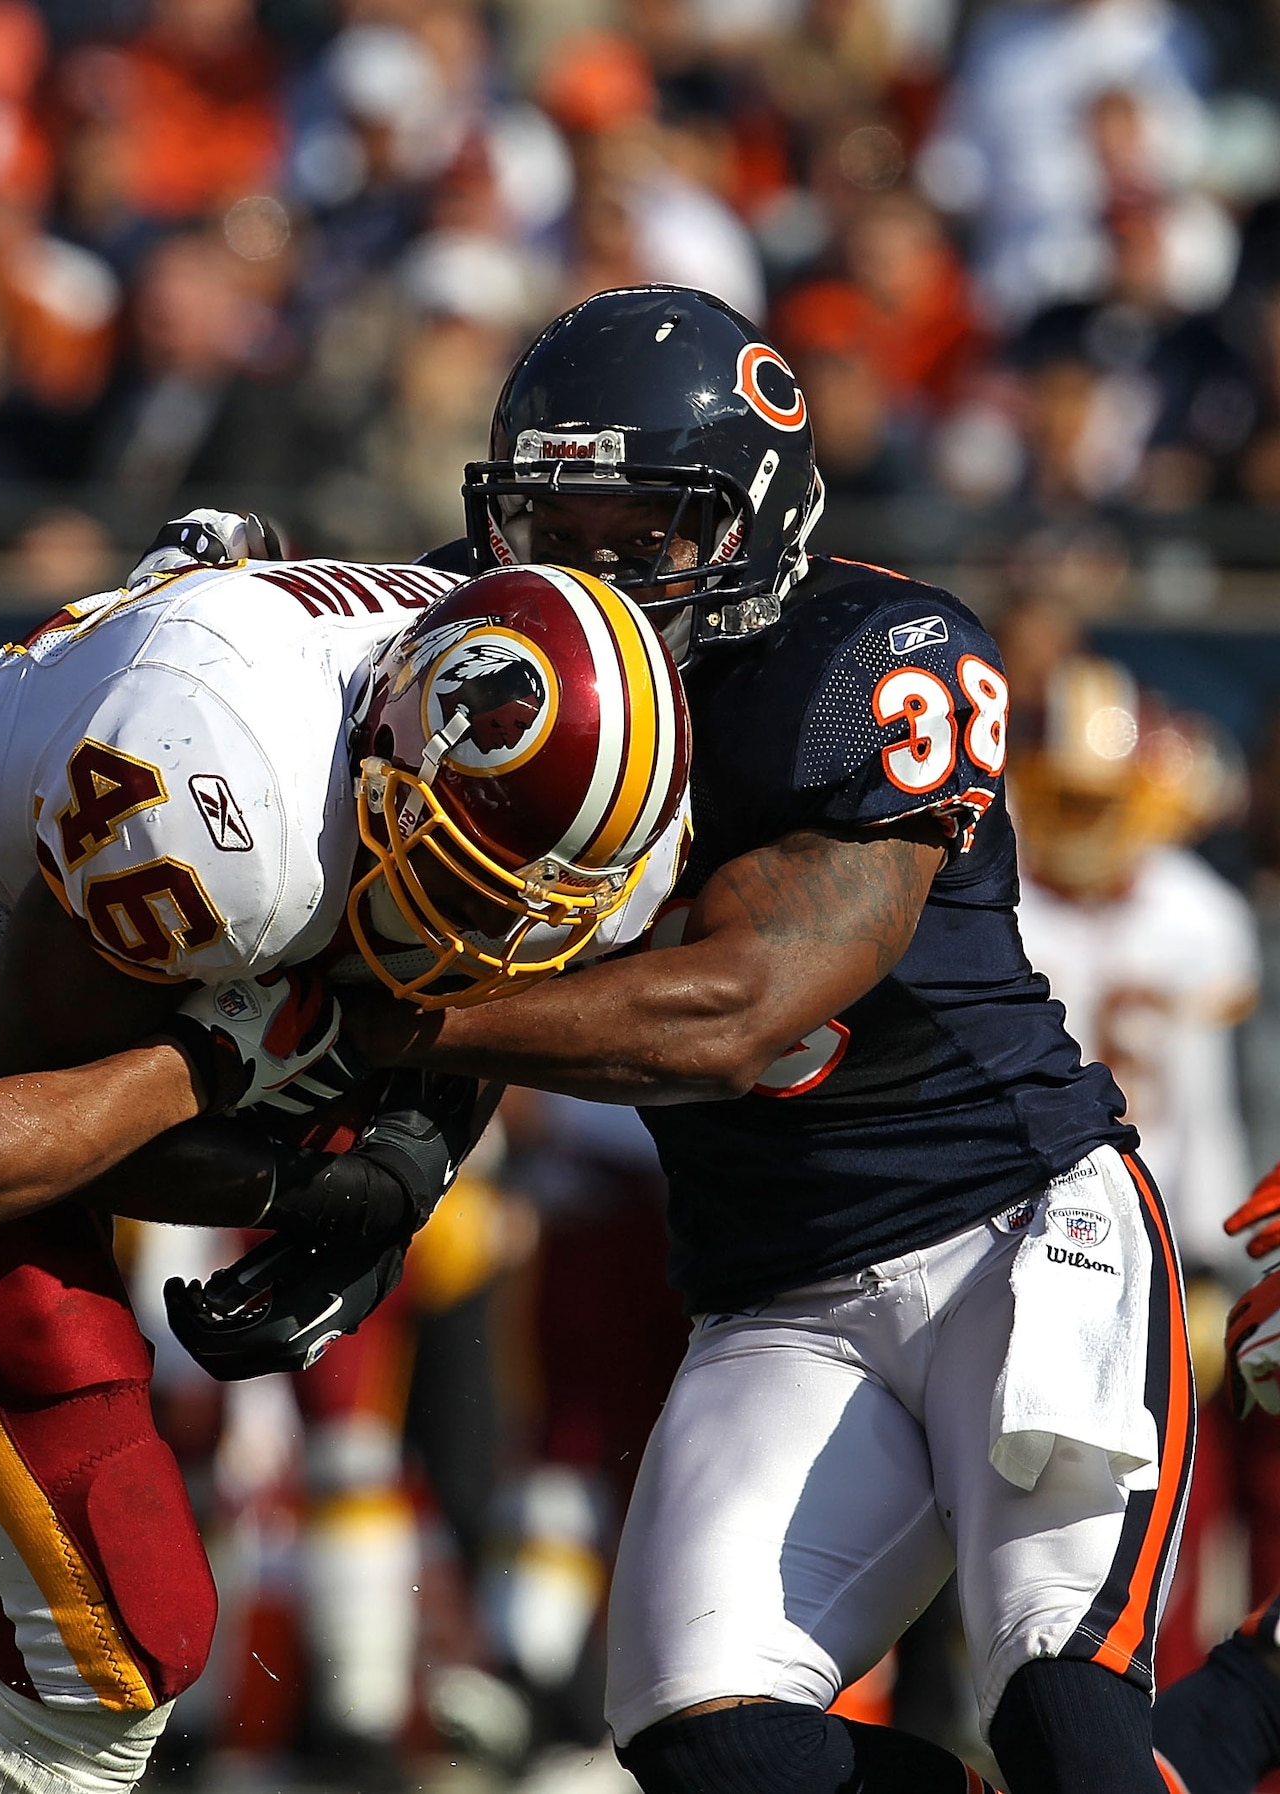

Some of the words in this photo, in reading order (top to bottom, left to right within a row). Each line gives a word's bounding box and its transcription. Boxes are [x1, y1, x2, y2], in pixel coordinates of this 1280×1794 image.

[732, 342, 807, 432] C
[249, 563, 461, 619] ORAIN
[872, 653, 1010, 795] 38
[53, 735, 228, 965] 46
[1051, 1209, 1108, 1224] EQUIPMENT
[1068, 1226, 1094, 1241] NFL
[1045, 1243, 1117, 1275] Wilson
